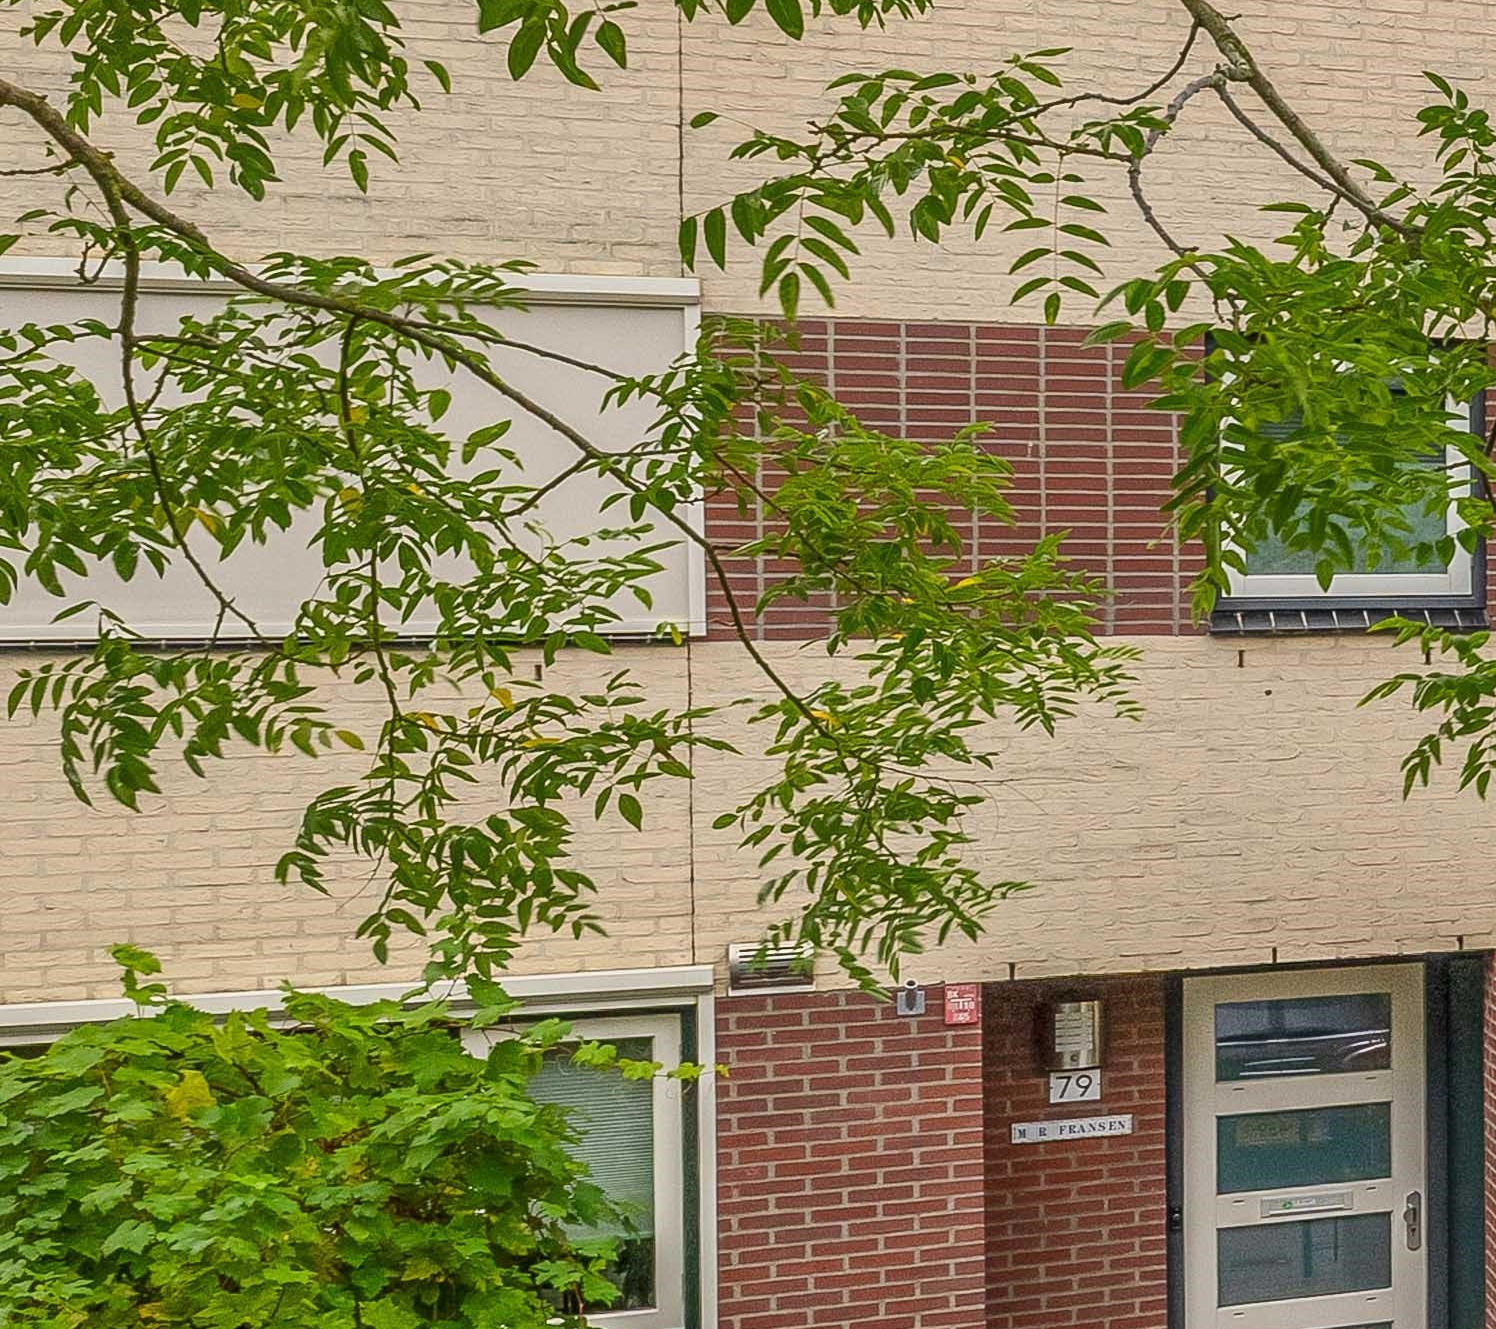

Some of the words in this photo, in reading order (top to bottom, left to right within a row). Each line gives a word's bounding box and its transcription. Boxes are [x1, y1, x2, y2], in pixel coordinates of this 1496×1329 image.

[1055, 1074, 1093, 1099] 79
[1017, 1127, 1027, 1139] M
[1058, 1119, 1127, 1136] FRANSEN
